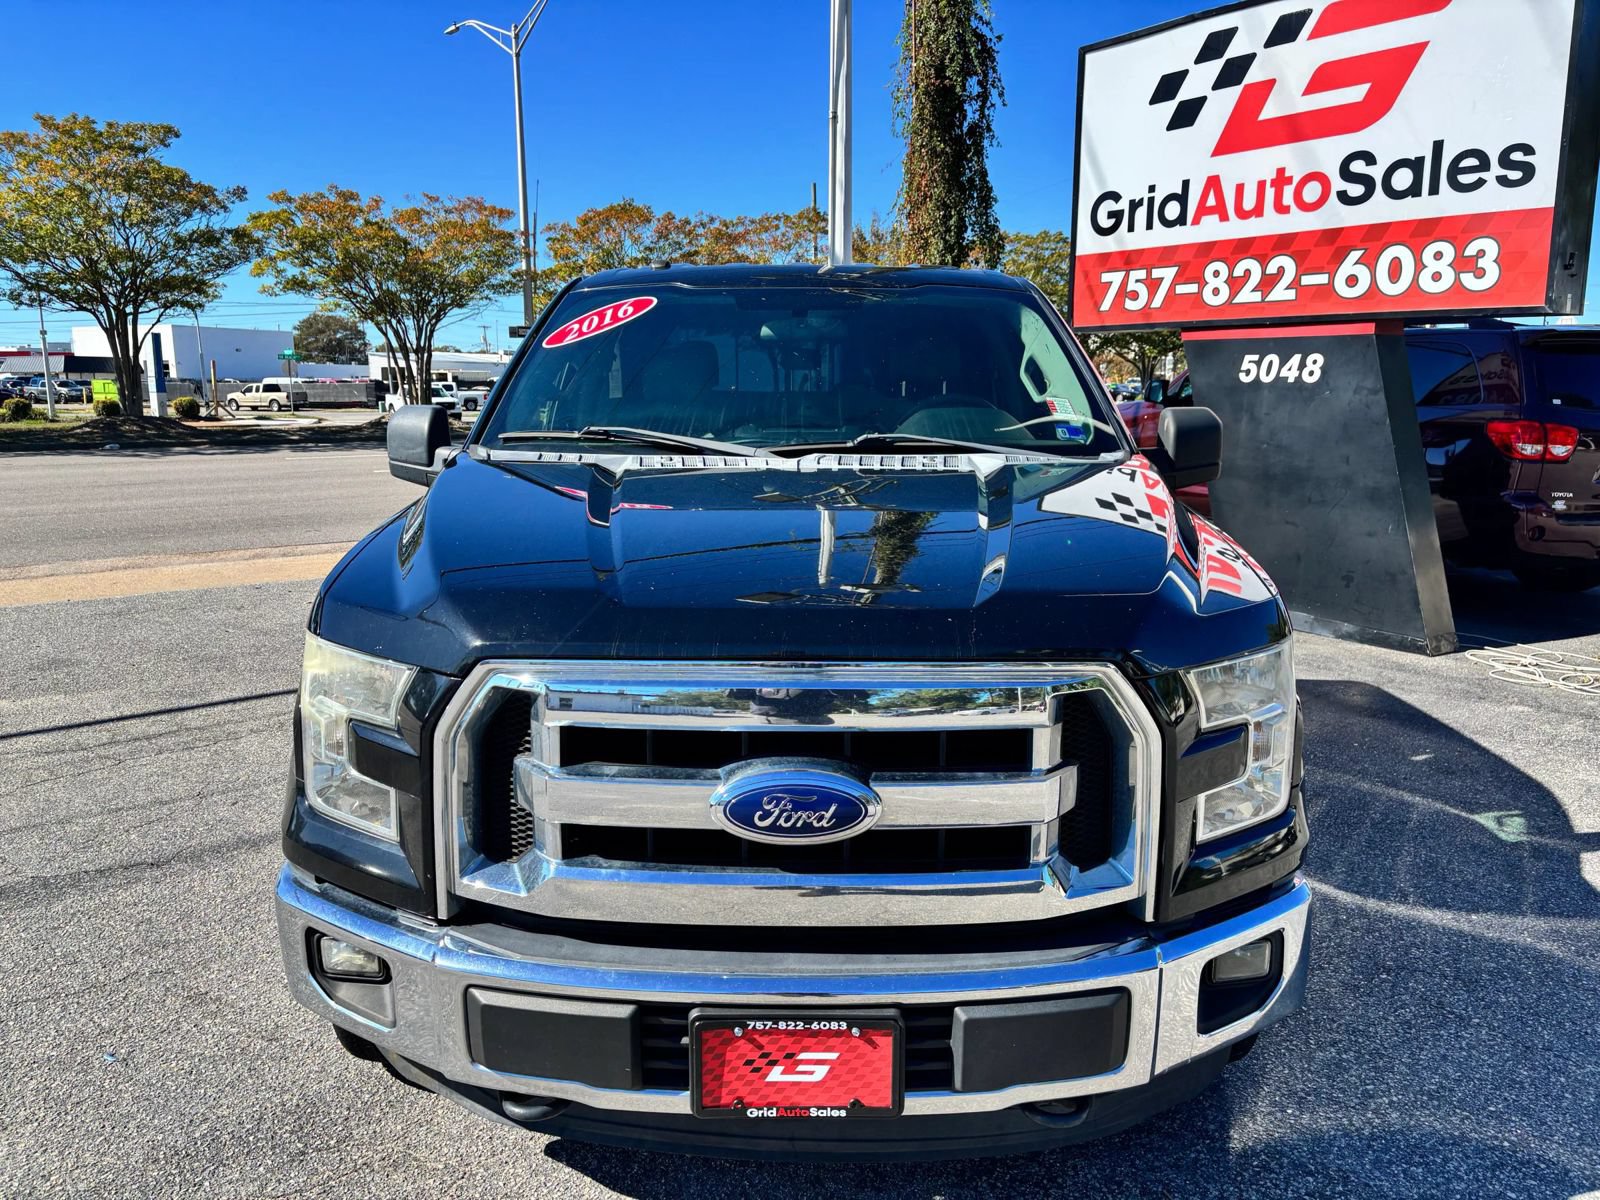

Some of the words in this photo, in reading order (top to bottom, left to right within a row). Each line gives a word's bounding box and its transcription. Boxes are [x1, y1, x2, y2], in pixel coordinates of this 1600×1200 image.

[1090, 139, 1537, 237] GridAutoSales
[1098, 236, 1502, 312] 757-822-6083
[565, 302, 635, 342] 2016
[1238, 353, 1325, 385] 5048
[753, 793, 837, 828] Ford
[746, 1021, 848, 1031] 757-822-6083
[746, 1107, 847, 1118] GridAutoSales
